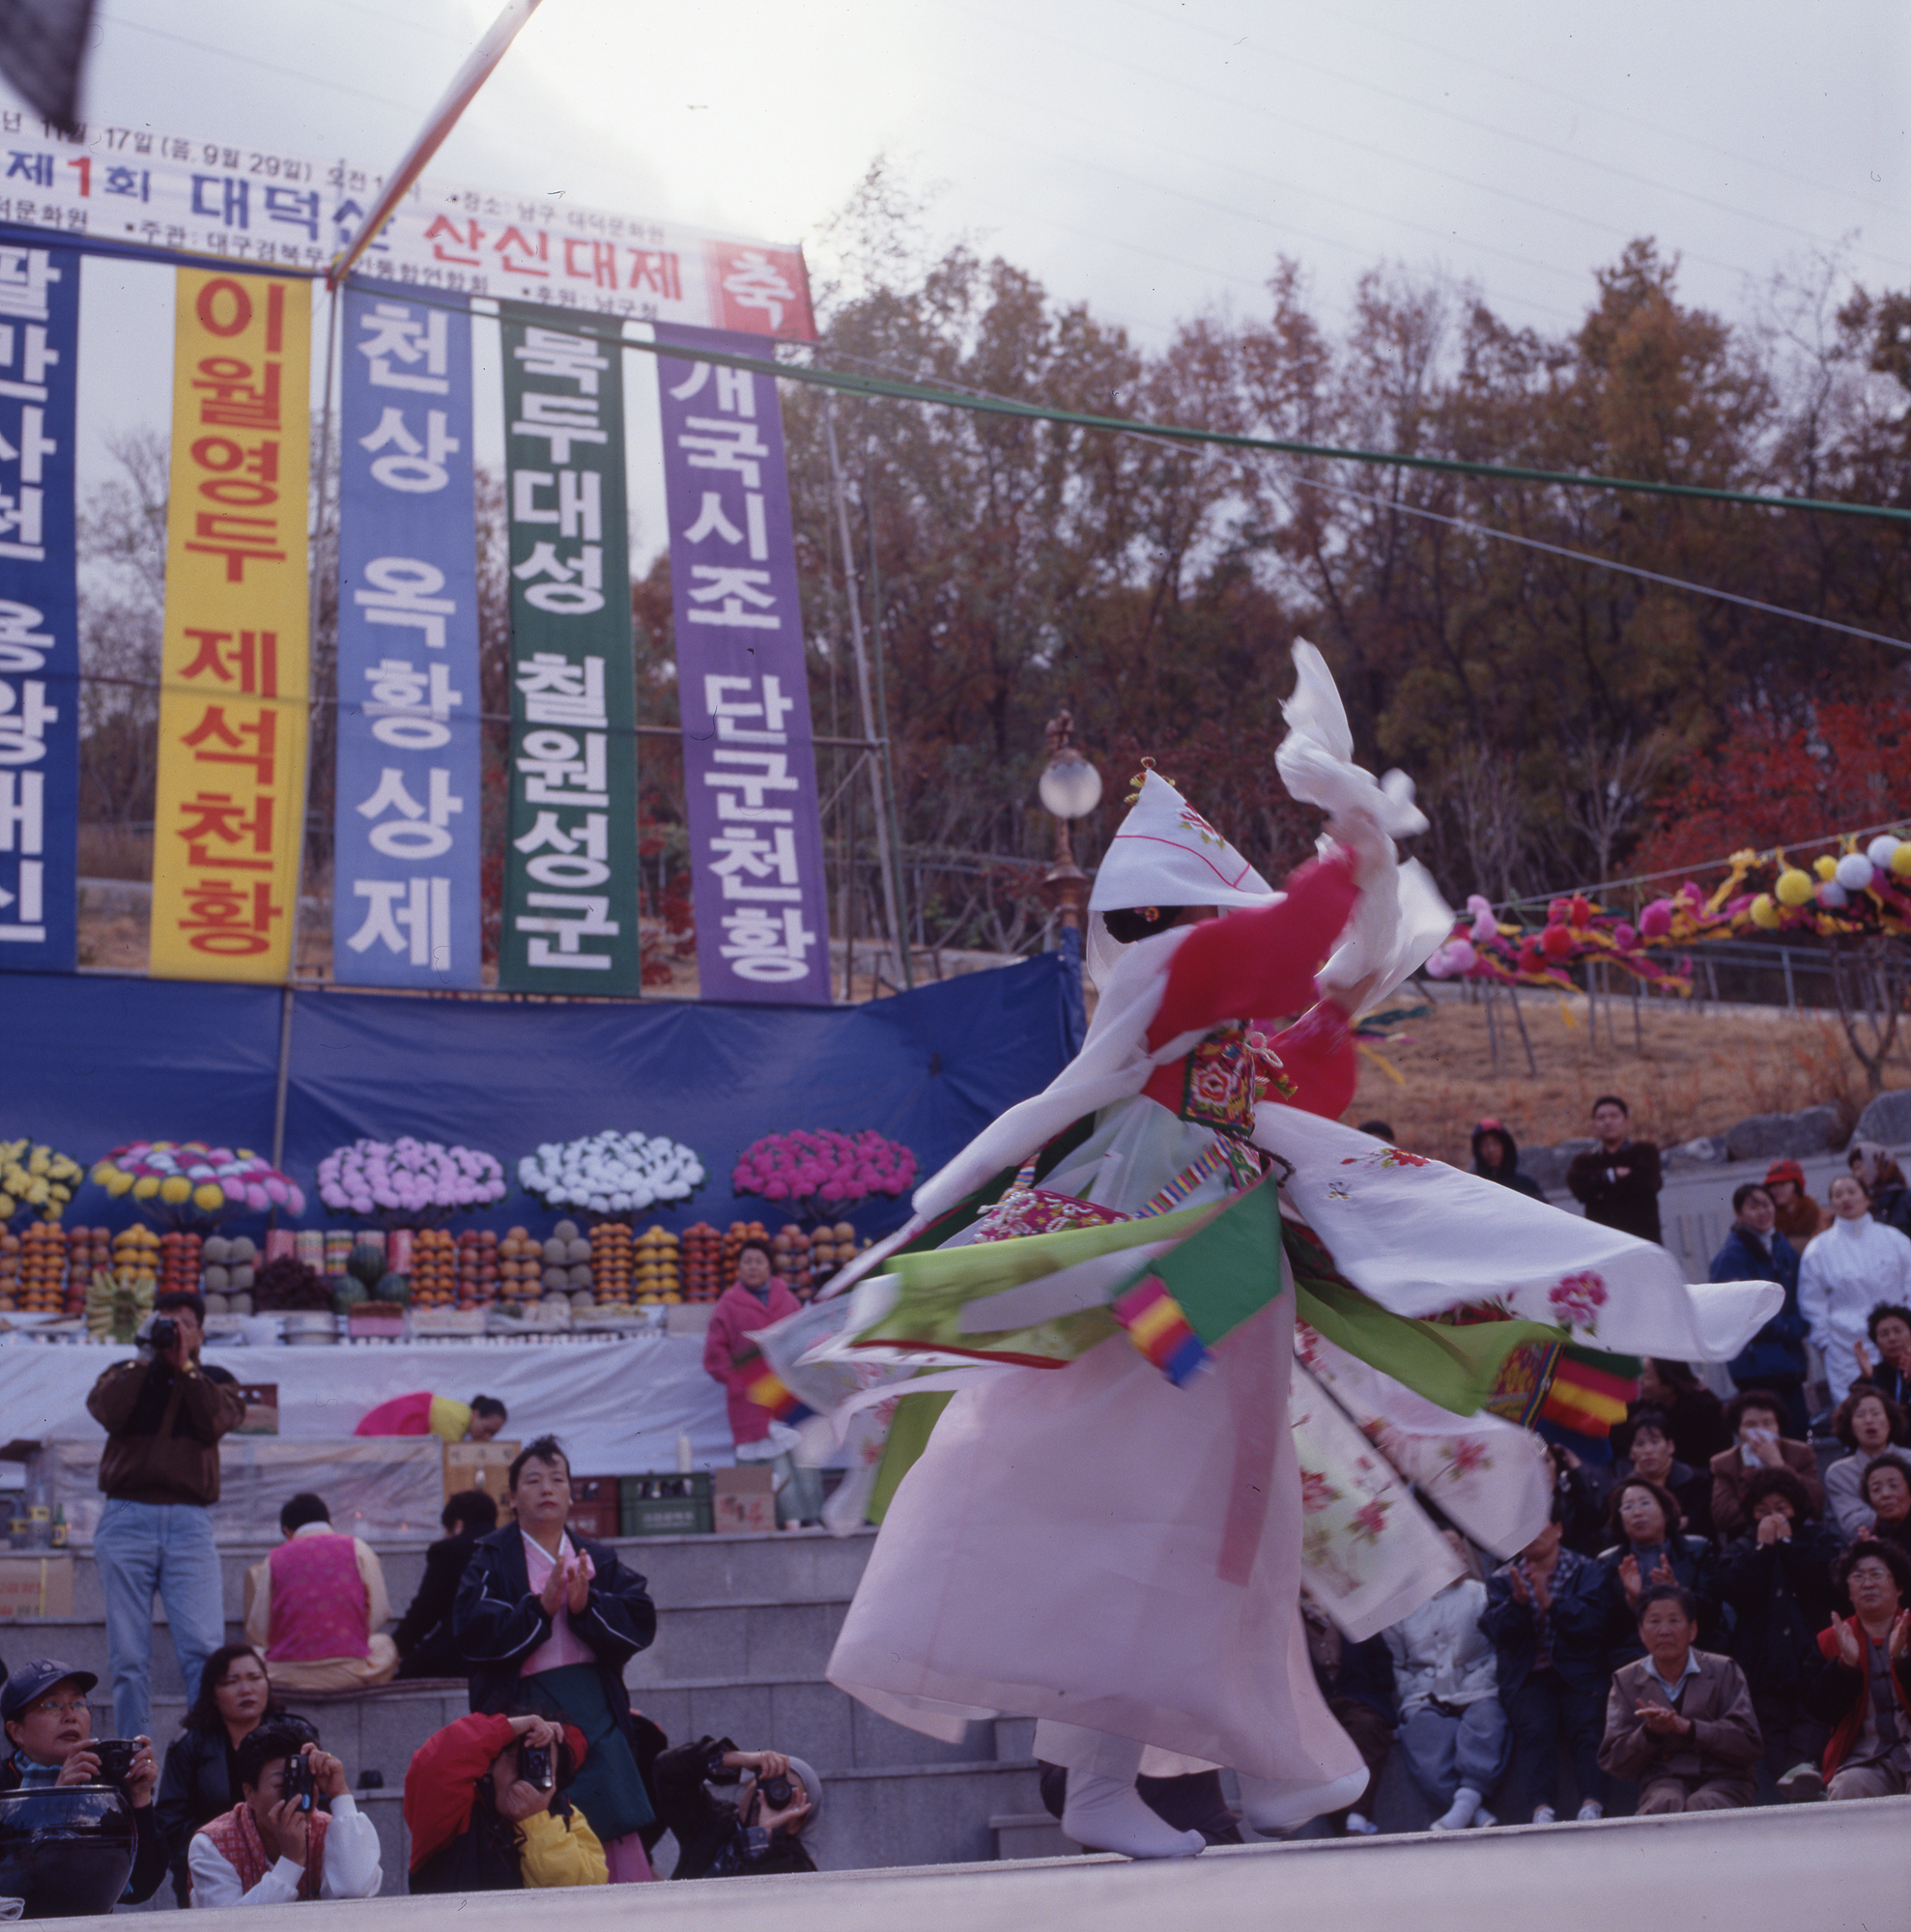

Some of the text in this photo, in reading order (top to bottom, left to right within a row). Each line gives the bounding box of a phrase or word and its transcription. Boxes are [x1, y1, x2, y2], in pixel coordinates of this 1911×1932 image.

[106, 128, 153, 154] 17일
[203, 145, 240, 169] 9월
[190, 174, 394, 251] 대덕산
[423, 213, 683, 300] 산신대제
[723, 251, 797, 331] 축
[357, 302, 459, 494] 천상
[176, 276, 286, 956] 이월영두 제석천황
[346, 556, 463, 972] 옥황상제
[512, 326, 619, 971] 북두대성 칠원성군
[670, 354, 816, 983] 개국시조 단군천황
